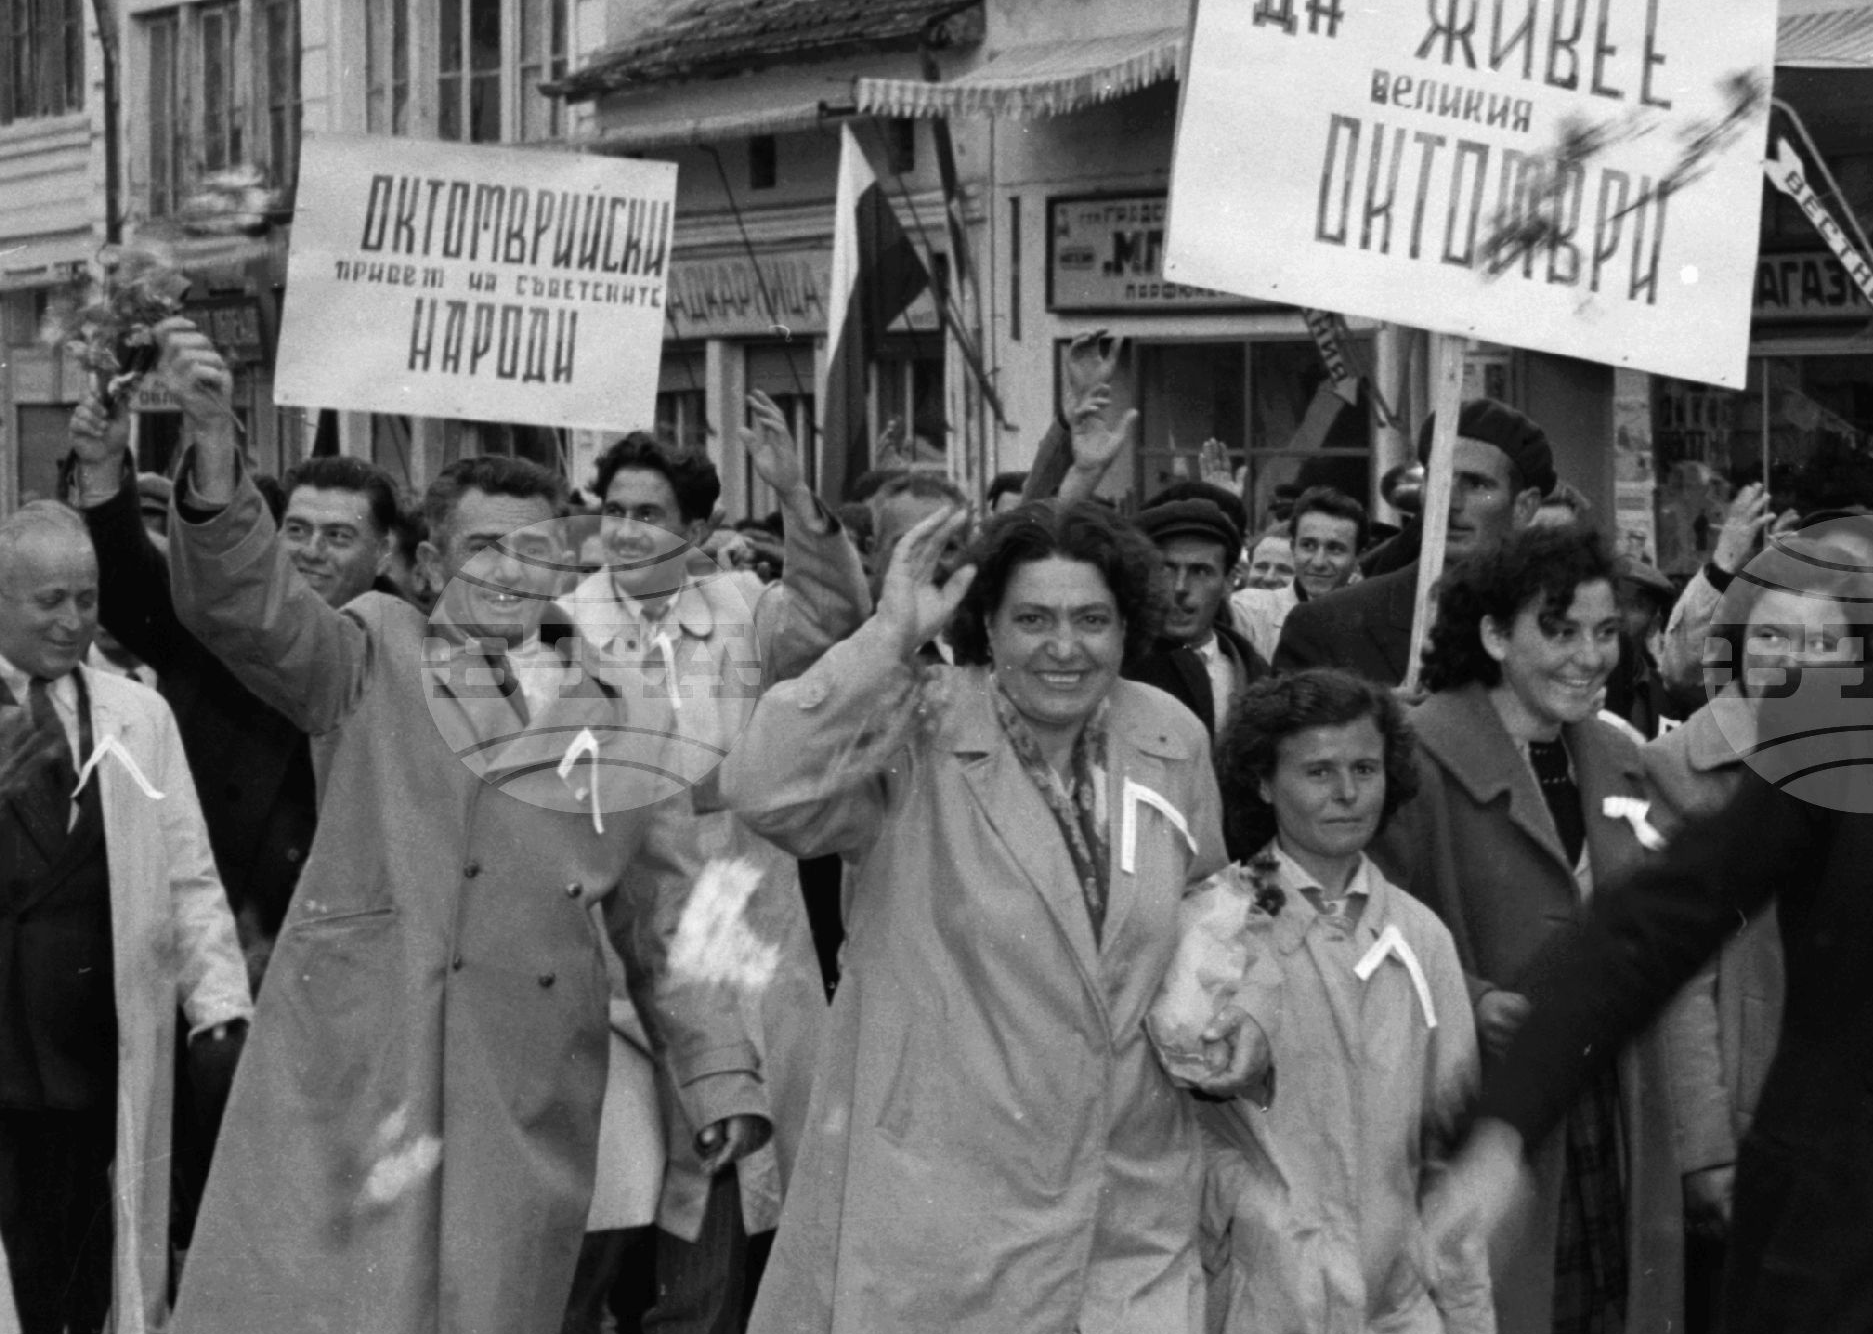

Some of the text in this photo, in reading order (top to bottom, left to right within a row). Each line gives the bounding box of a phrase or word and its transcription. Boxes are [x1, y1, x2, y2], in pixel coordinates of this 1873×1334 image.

[361, 174, 670, 277] ОКТОМВРИЙСКИ
[1315, 113, 1673, 306] ОКТОМВРИ
[516, 274, 662, 309] СЪВЕТСКИТЕ
[408, 297, 579, 383] НАРОДИ
